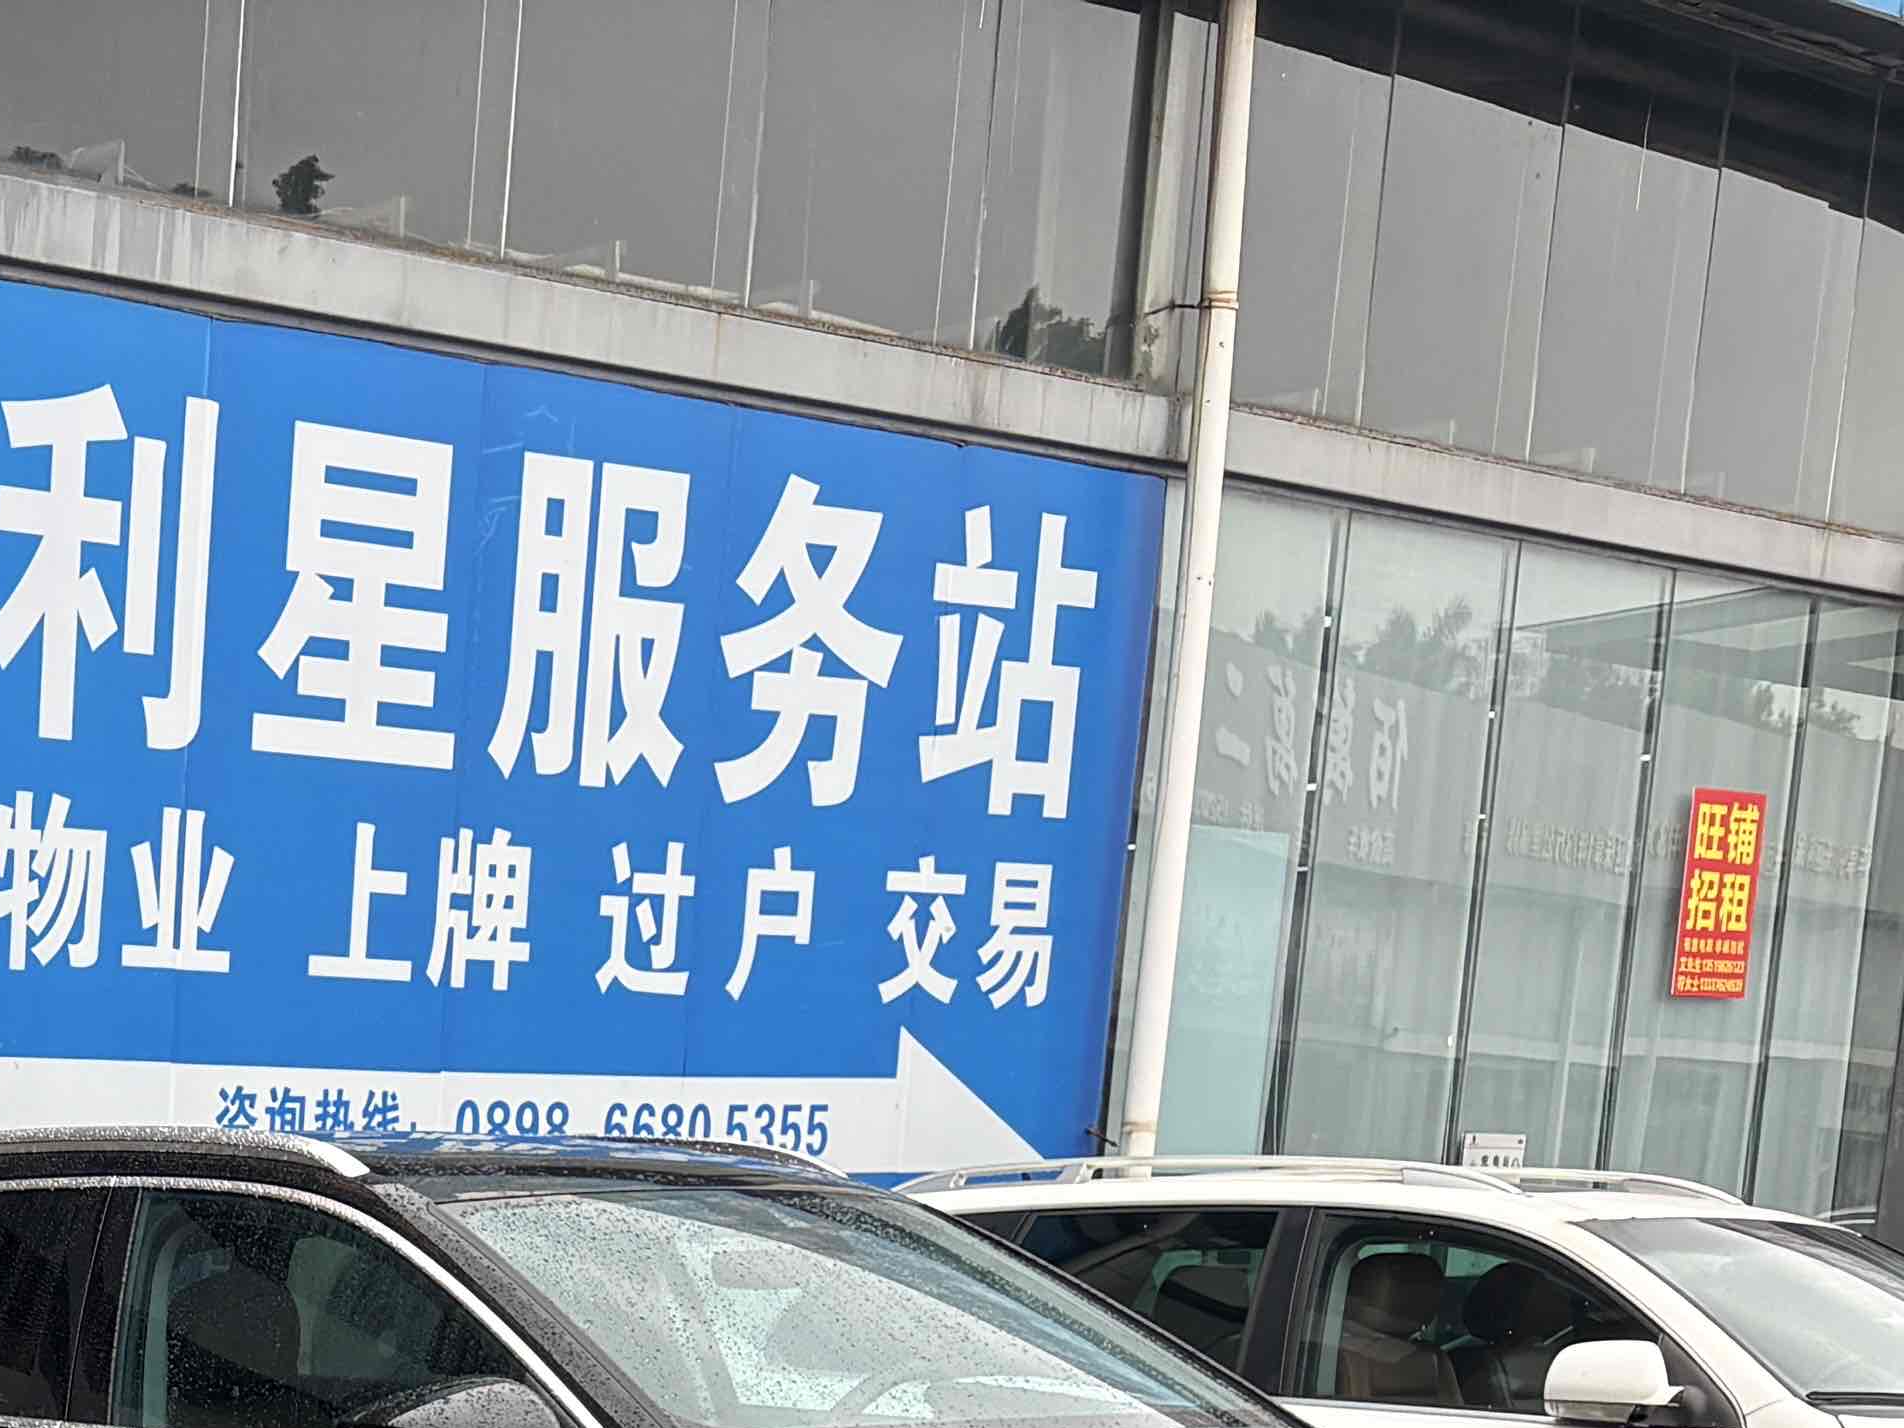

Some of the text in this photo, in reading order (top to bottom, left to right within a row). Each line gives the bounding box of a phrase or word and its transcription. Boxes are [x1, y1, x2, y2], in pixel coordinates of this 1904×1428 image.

[1694, 802, 1760, 865] 旺铺
[308, 821, 533, 991] 上牌
[595, 839, 816, 1002] 过户
[878, 854, 1055, 1010] 交易
[1685, 868, 1752, 932] 招租
